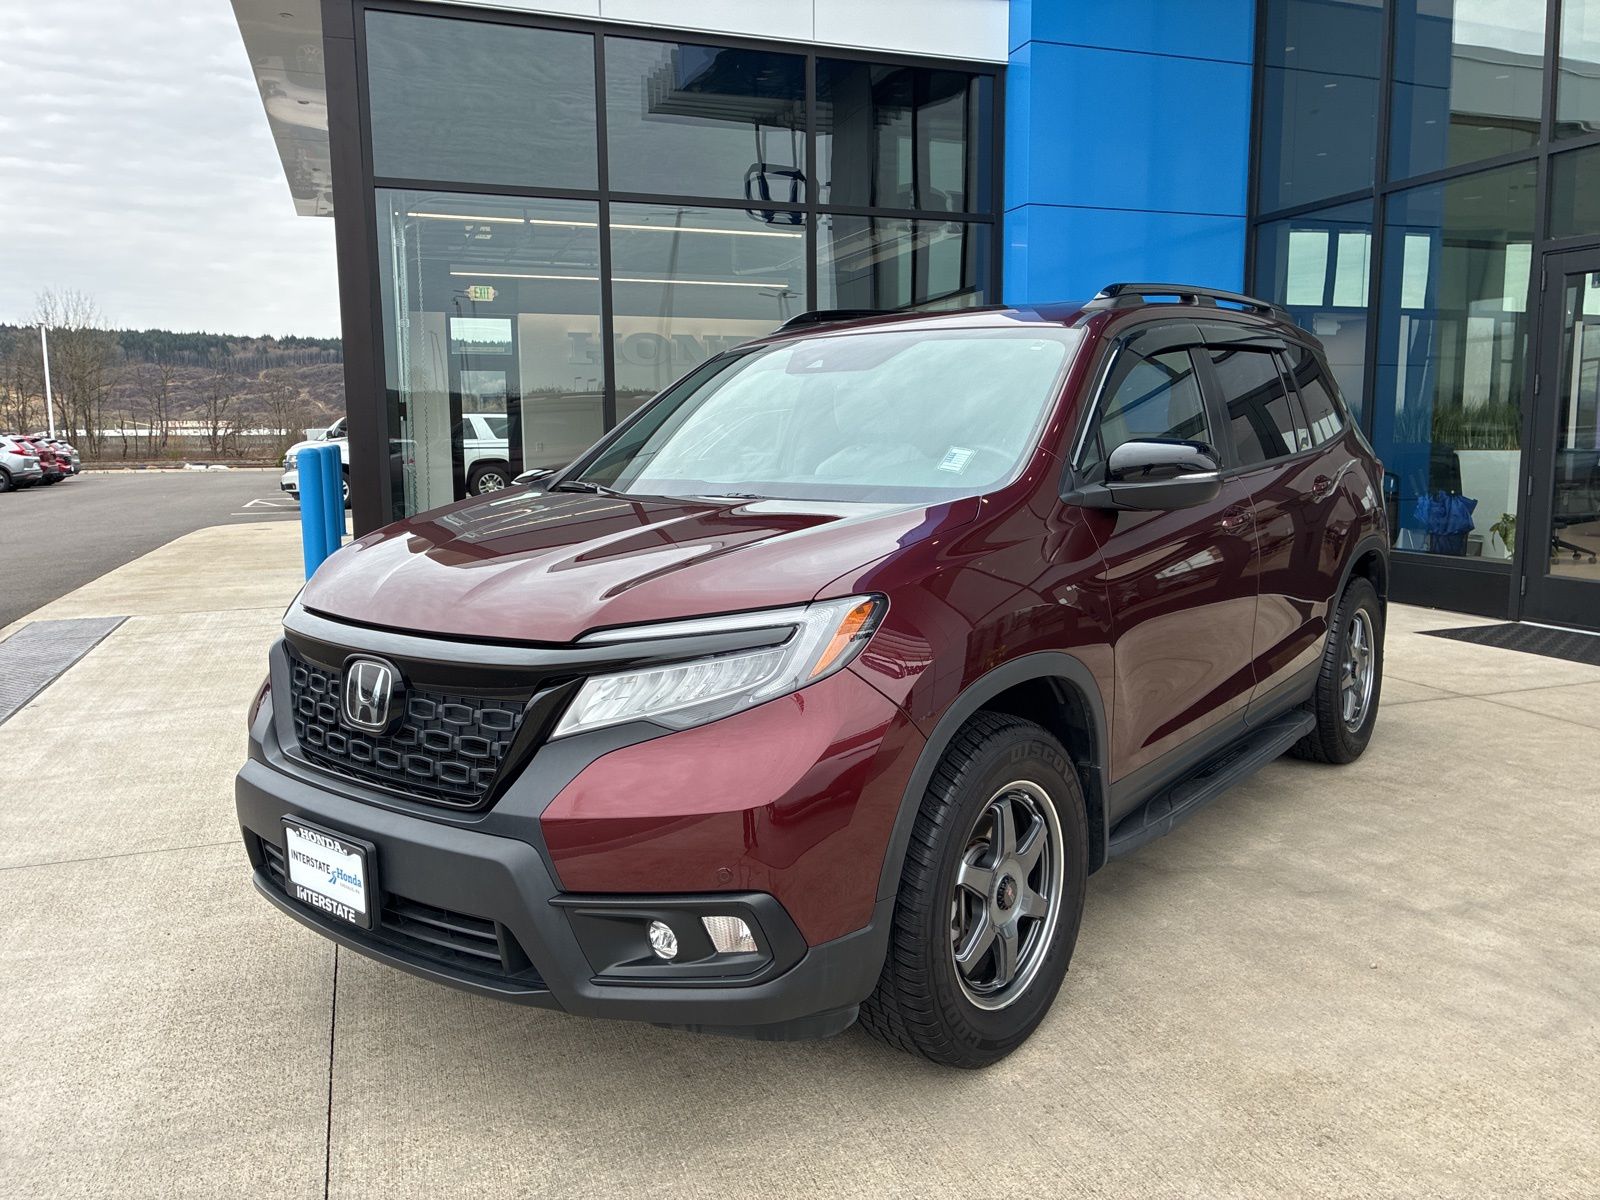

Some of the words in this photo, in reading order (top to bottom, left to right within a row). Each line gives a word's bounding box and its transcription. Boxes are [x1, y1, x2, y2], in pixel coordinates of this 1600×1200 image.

[473, 286, 490, 300] EXIT
[567, 331, 760, 367] HON
[299, 828, 344, 855] HONDA
[291, 849, 331, 875] INTERSTATE
[336, 867, 362, 888] Honda
[296, 885, 356, 923] INTERSTATE
